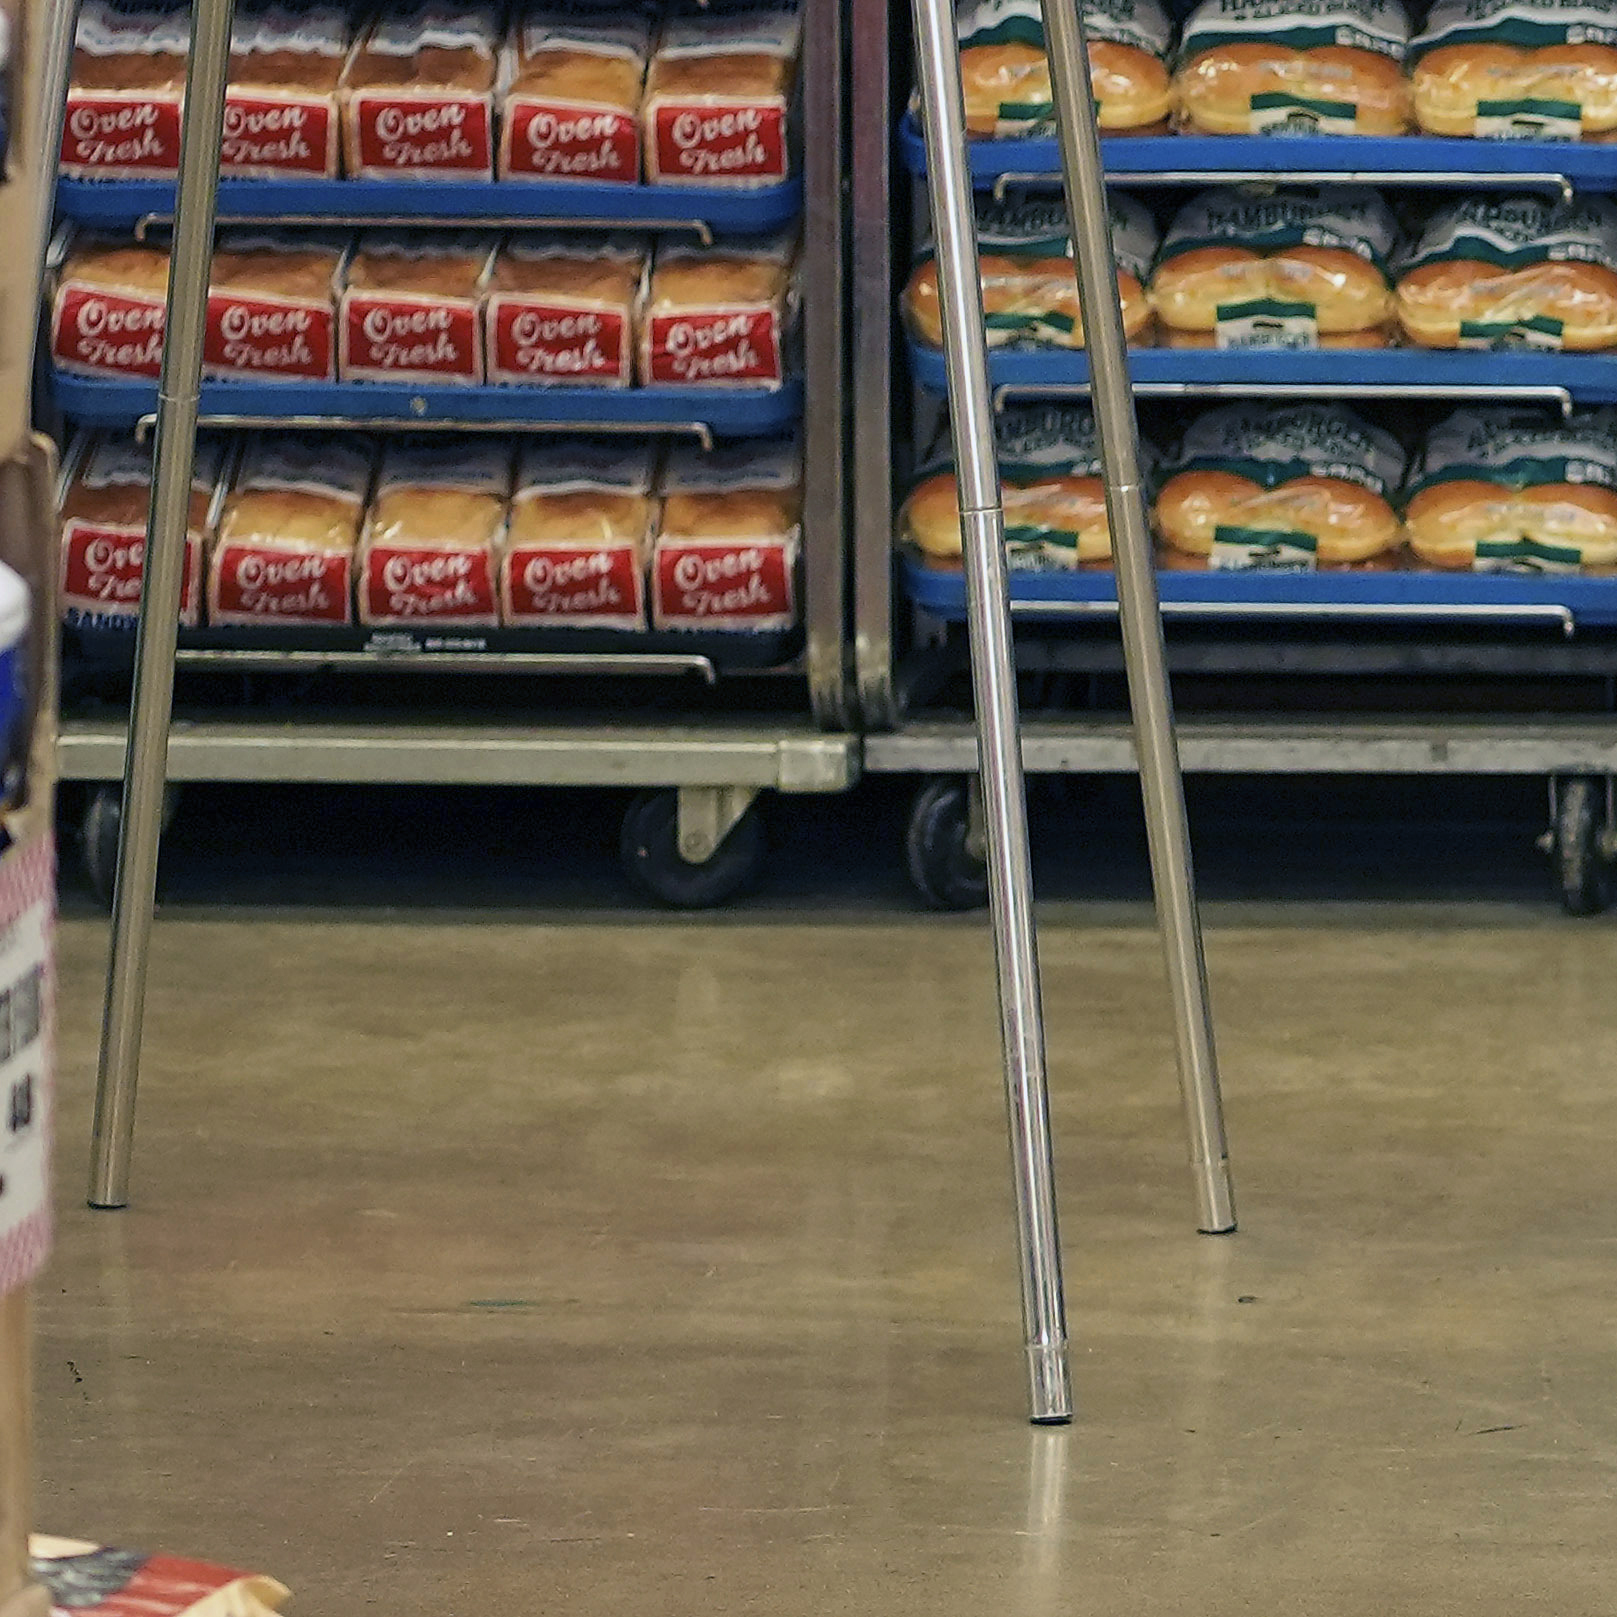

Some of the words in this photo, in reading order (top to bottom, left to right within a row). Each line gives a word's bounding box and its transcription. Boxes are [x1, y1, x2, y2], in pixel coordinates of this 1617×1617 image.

[69, 104, 157, 139] Oven
[375, 106, 467, 142] Oven
[527, 110, 618, 147] Oven
[673, 106, 763, 147] Oven
[220, 304, 311, 341] Oven
[362, 305, 452, 343] Oven
[510, 310, 601, 347] Oven
[666, 315, 753, 358] Oven
[235, 553, 326, 594] Oven
[383, 551, 473, 594] Oven
[524, 549, 612, 594] Oven
[673, 548, 764, 591] Oven
